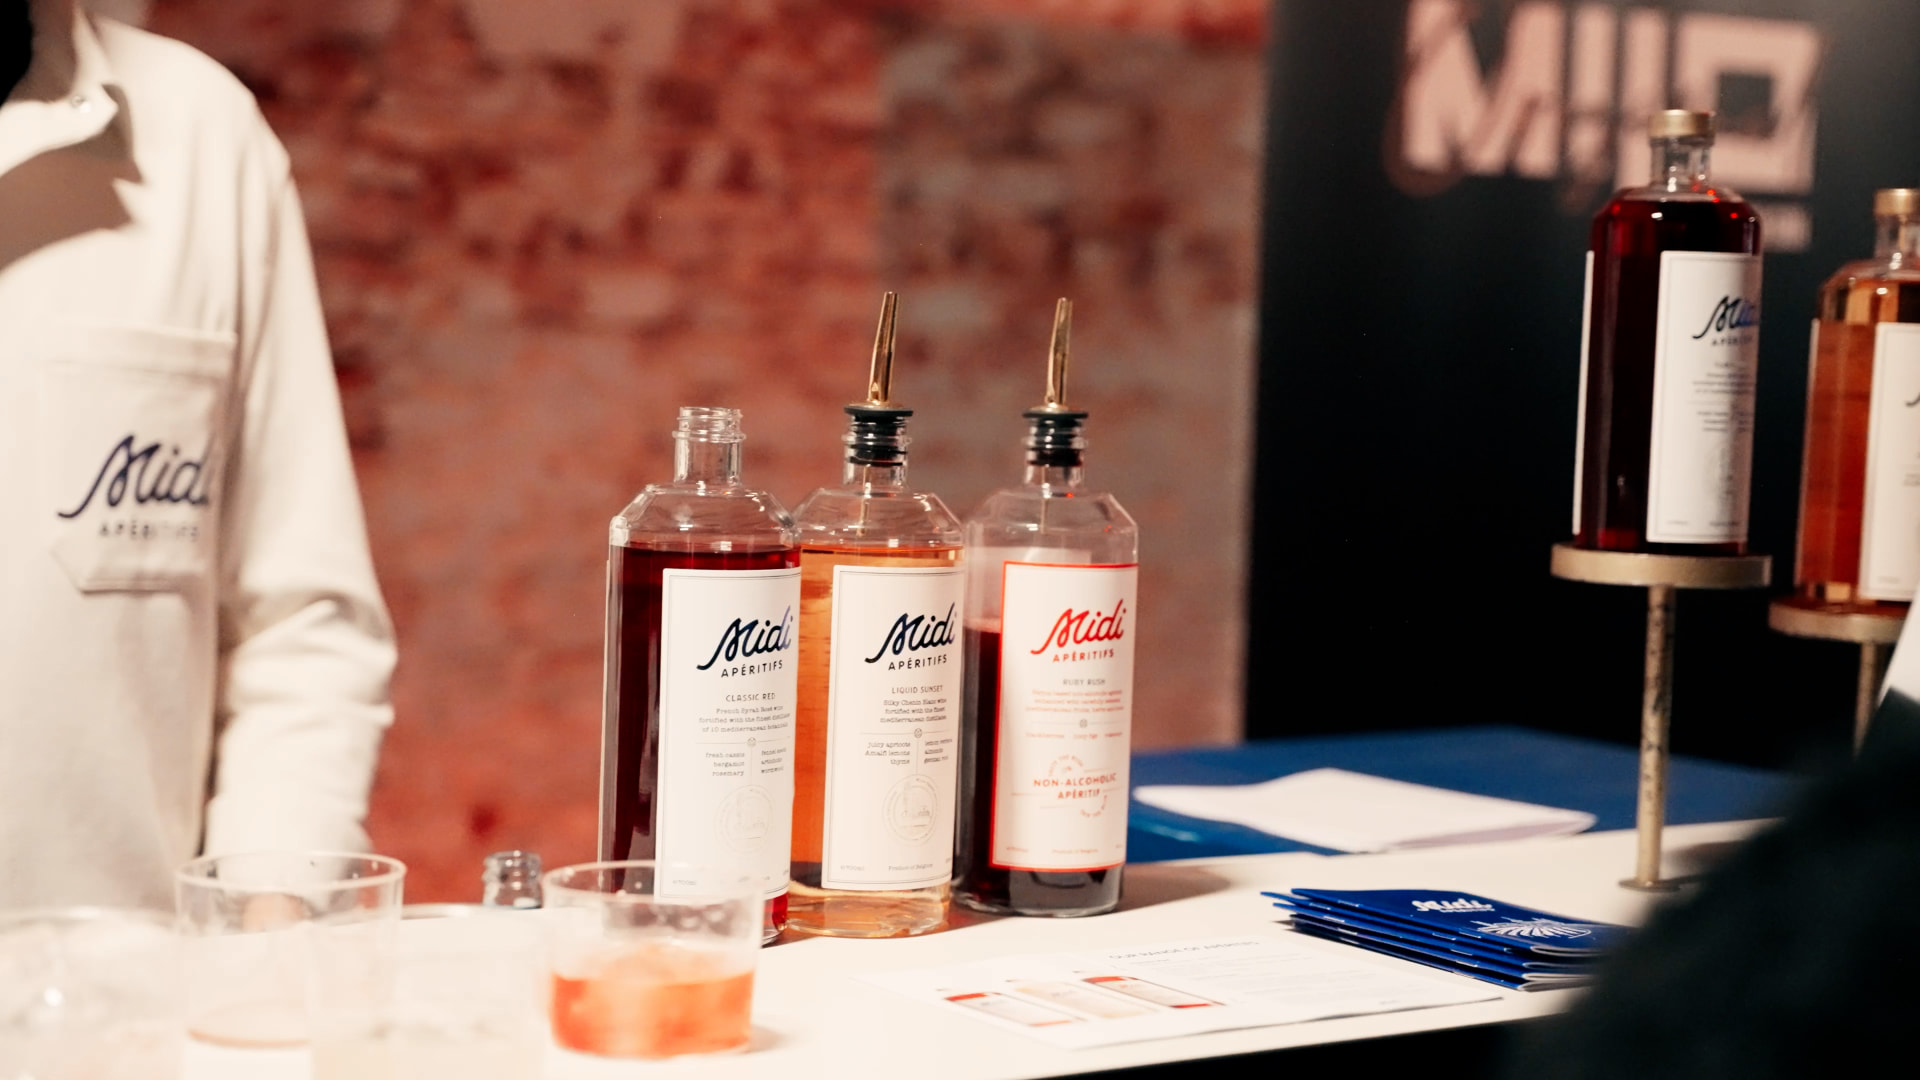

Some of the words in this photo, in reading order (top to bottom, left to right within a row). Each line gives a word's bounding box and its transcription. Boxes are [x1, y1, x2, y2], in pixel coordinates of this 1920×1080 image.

[864, 601, 956, 664] Midi
[1030, 598, 1127, 656] Midi
[696, 605, 794, 671] Midi
[888, 654, 948, 671] APÉRITIFS
[1052, 647, 1115, 663] APÉRITIFS
[721, 659, 783, 678] APÉRITIFS
[725, 693, 760, 703] CLASSIC
[762, 692, 776, 701] RED
[891, 686, 919, 695] LIQUID
[920, 685, 944, 694] SUNSET
